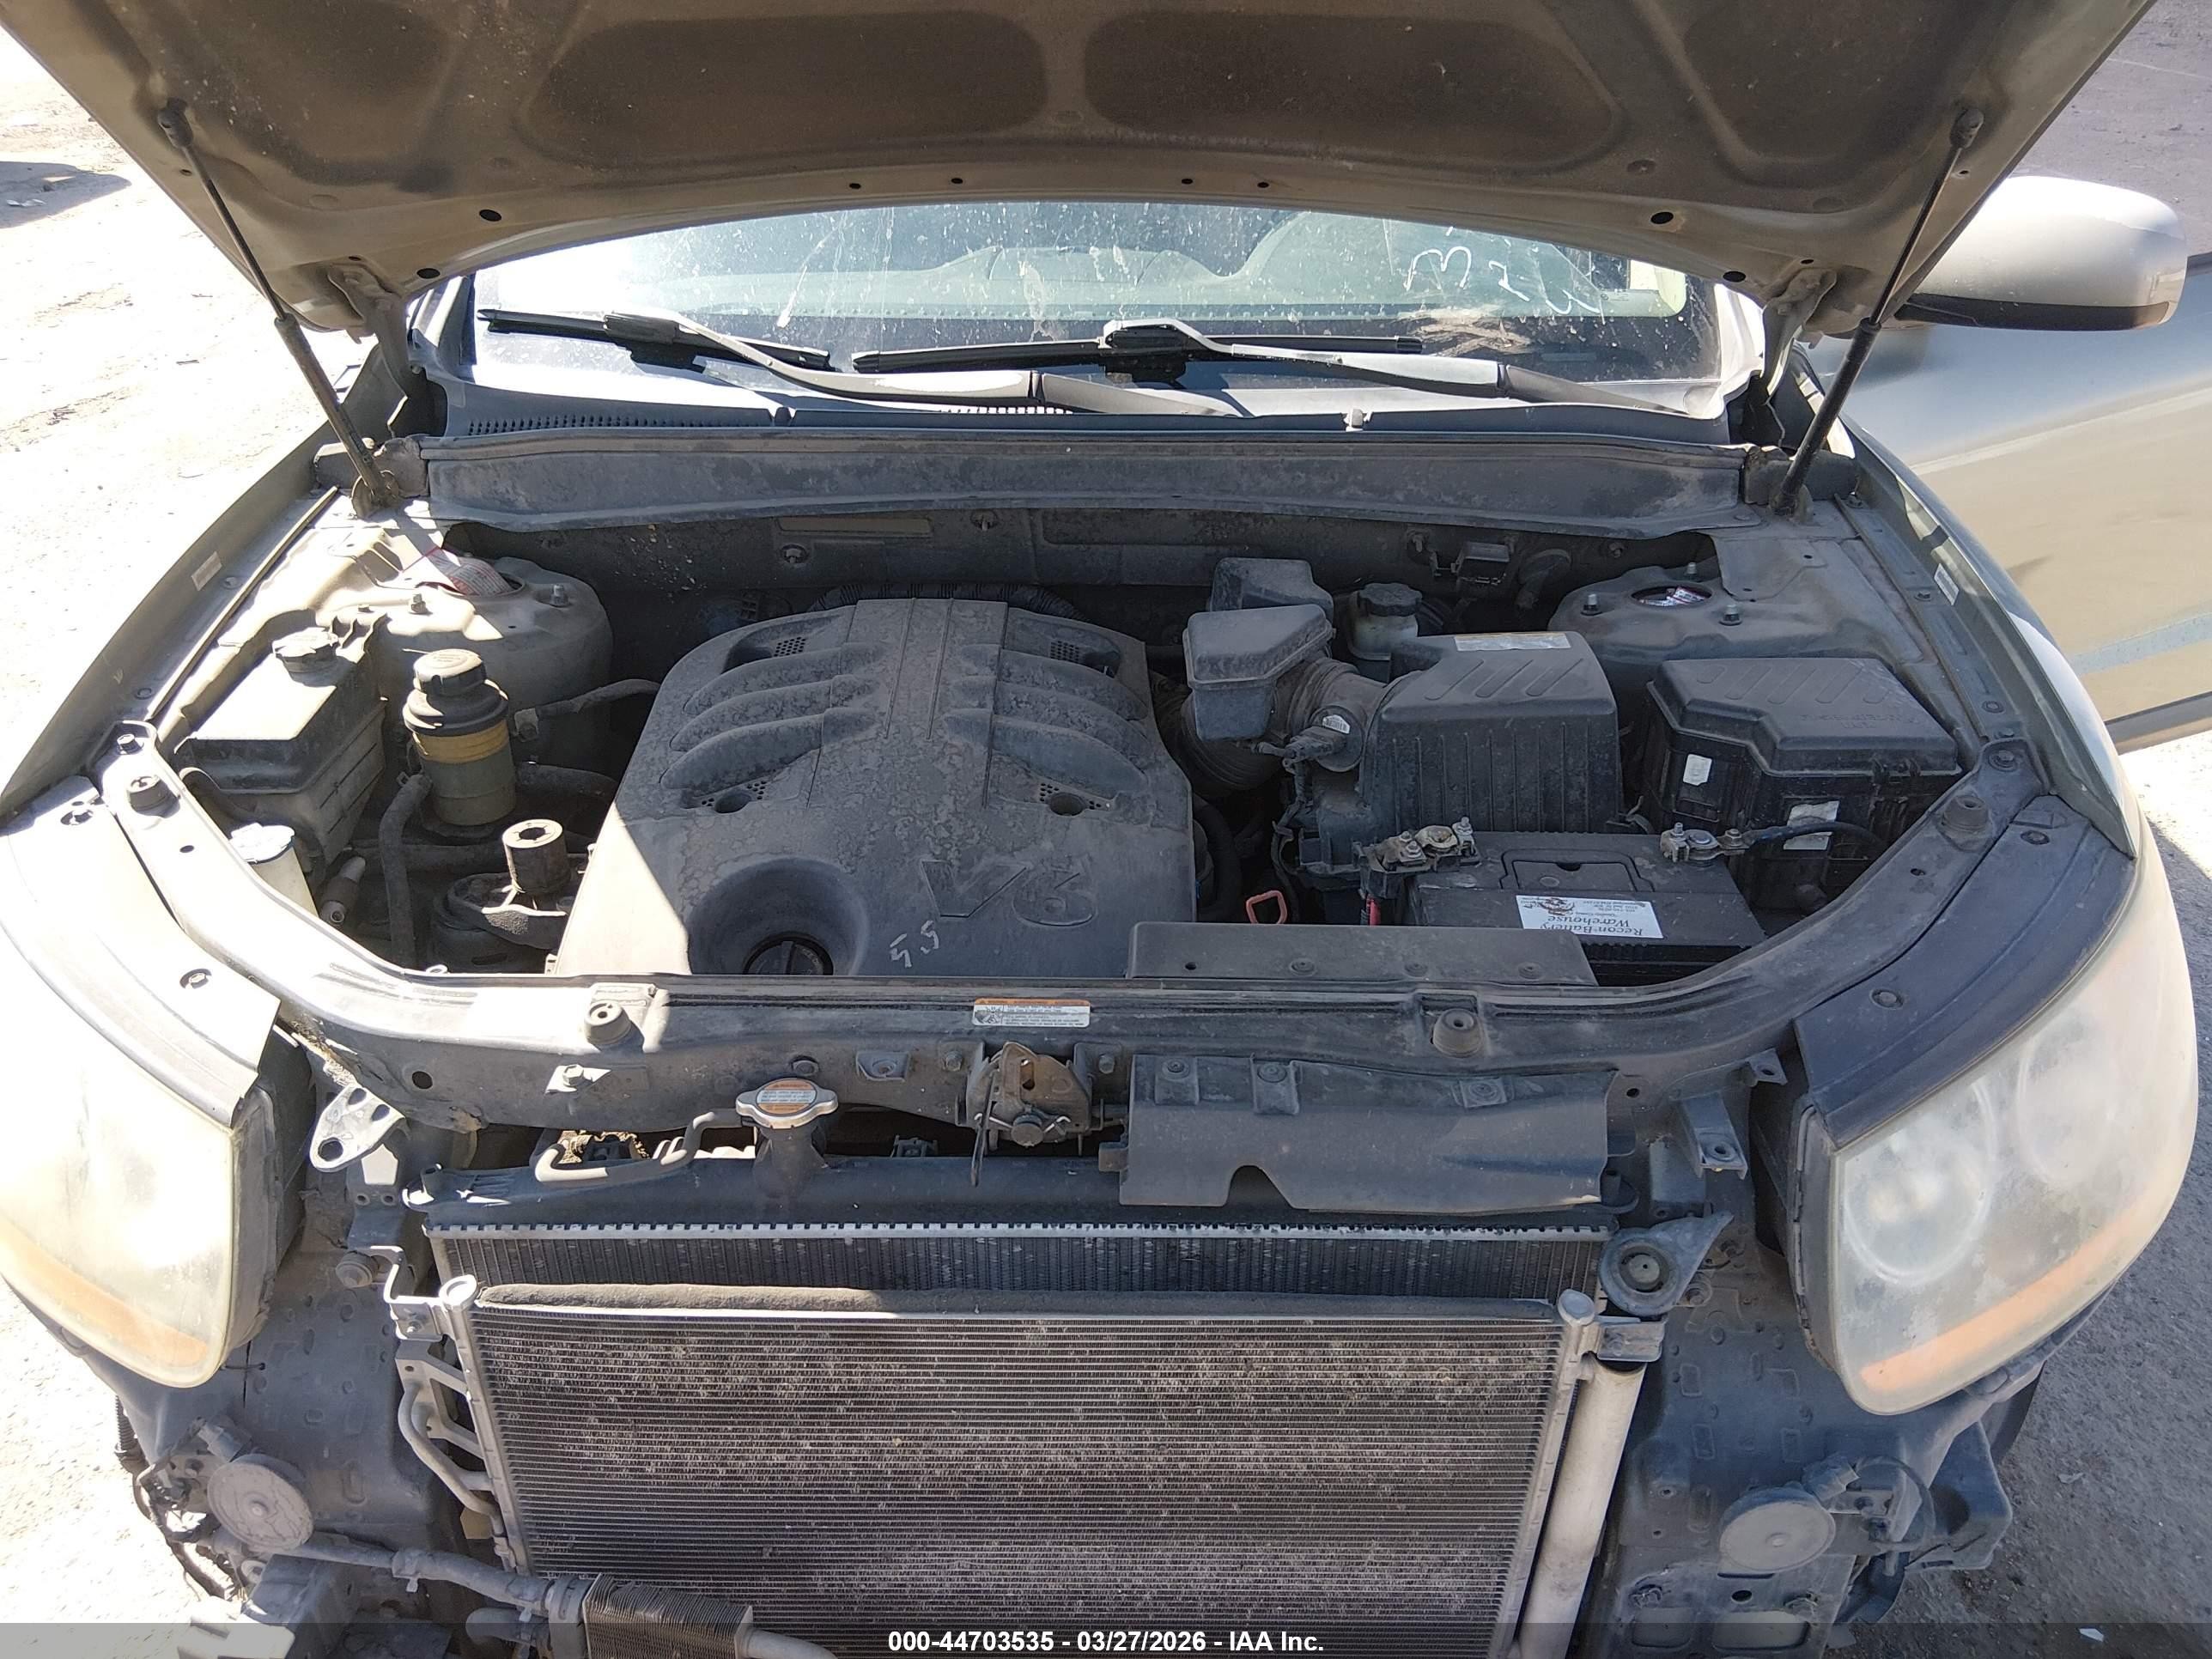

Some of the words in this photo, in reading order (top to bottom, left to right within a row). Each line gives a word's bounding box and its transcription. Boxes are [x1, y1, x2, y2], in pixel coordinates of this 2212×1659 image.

[921, 858, 1100, 927] V6
[1547, 915, 1630, 927] Warehouse
[1597, 927, 1643, 936] Recon
